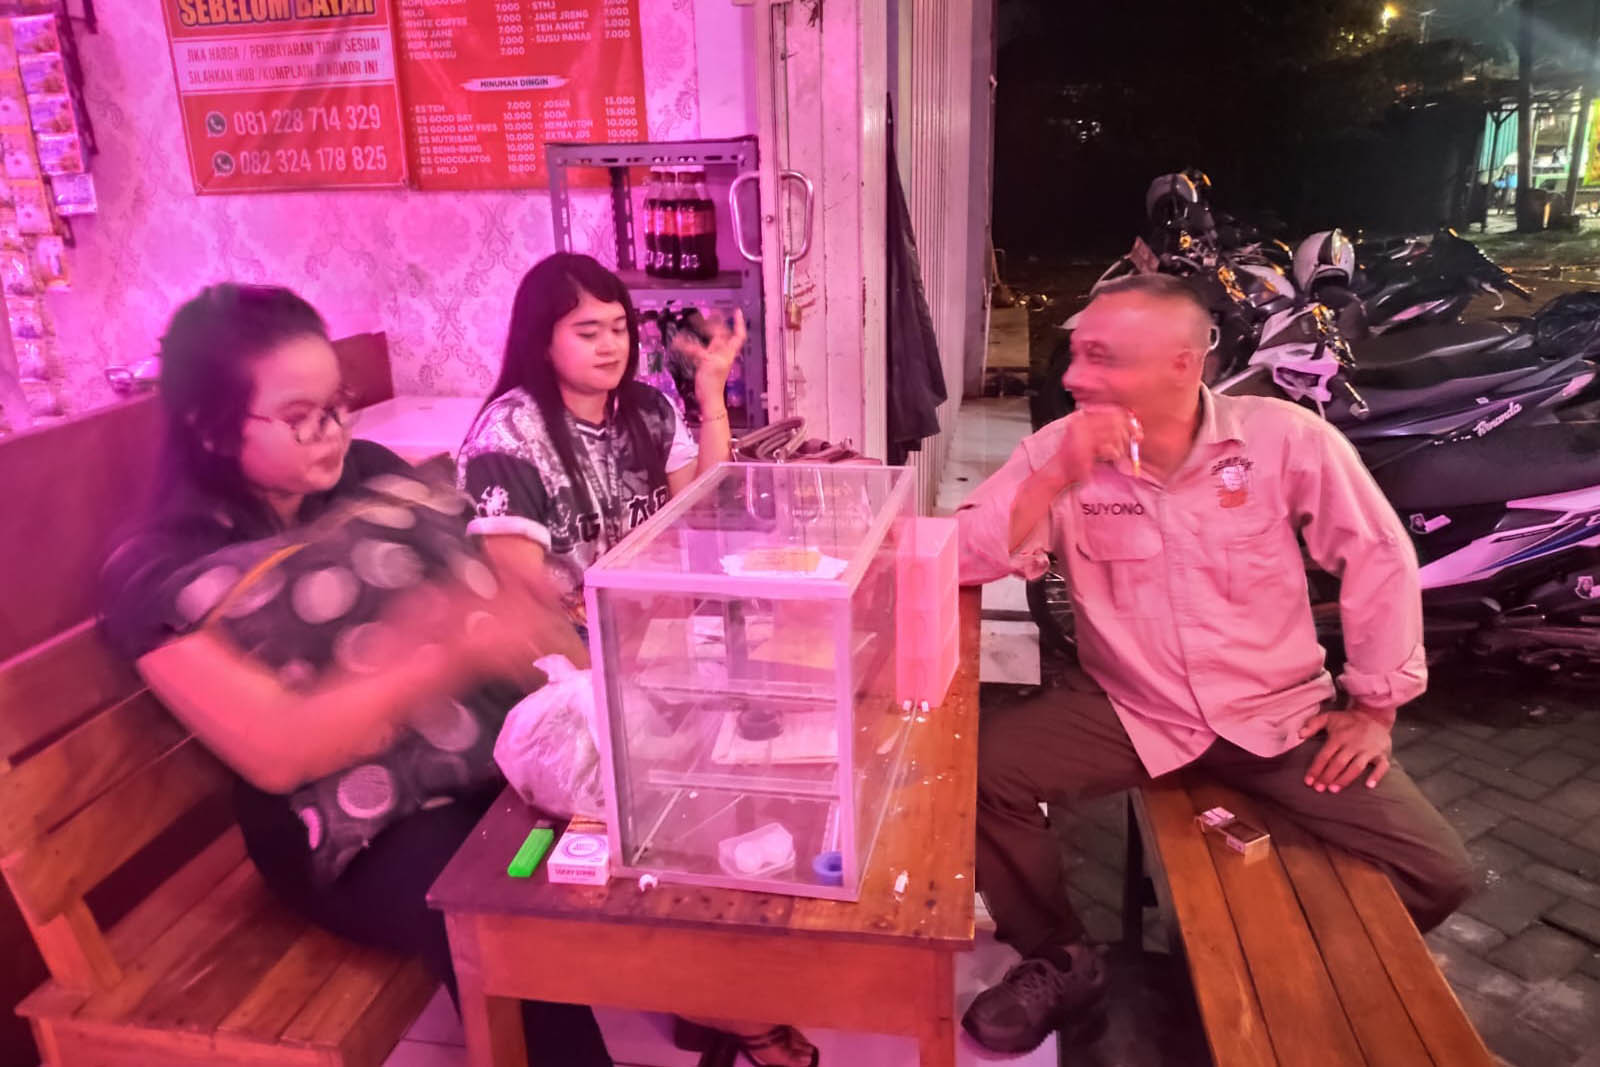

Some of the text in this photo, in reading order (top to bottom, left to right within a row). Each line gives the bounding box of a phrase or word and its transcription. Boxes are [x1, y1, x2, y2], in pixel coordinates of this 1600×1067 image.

[555, 21, 584, 30] ANGET
[208, 46, 240, 61] HARGA
[249, 42, 314, 60] PEMBAYARAN
[344, 38, 380, 52] SESUAI
[188, 69, 233, 84] SILAHKAN
[326, 61, 361, 76] NOMOR
[364, 60, 378, 74] INI
[480, 78, 549, 88] MINUMAN DINGIN
[234, 104, 381, 136] 081 228 714 329
[608, 118, 638, 127] 10.000
[608, 128, 639, 137] 10.000
[240, 145, 387, 174] 082 324 178 825
[1082, 503, 1144, 516] SUYONO
